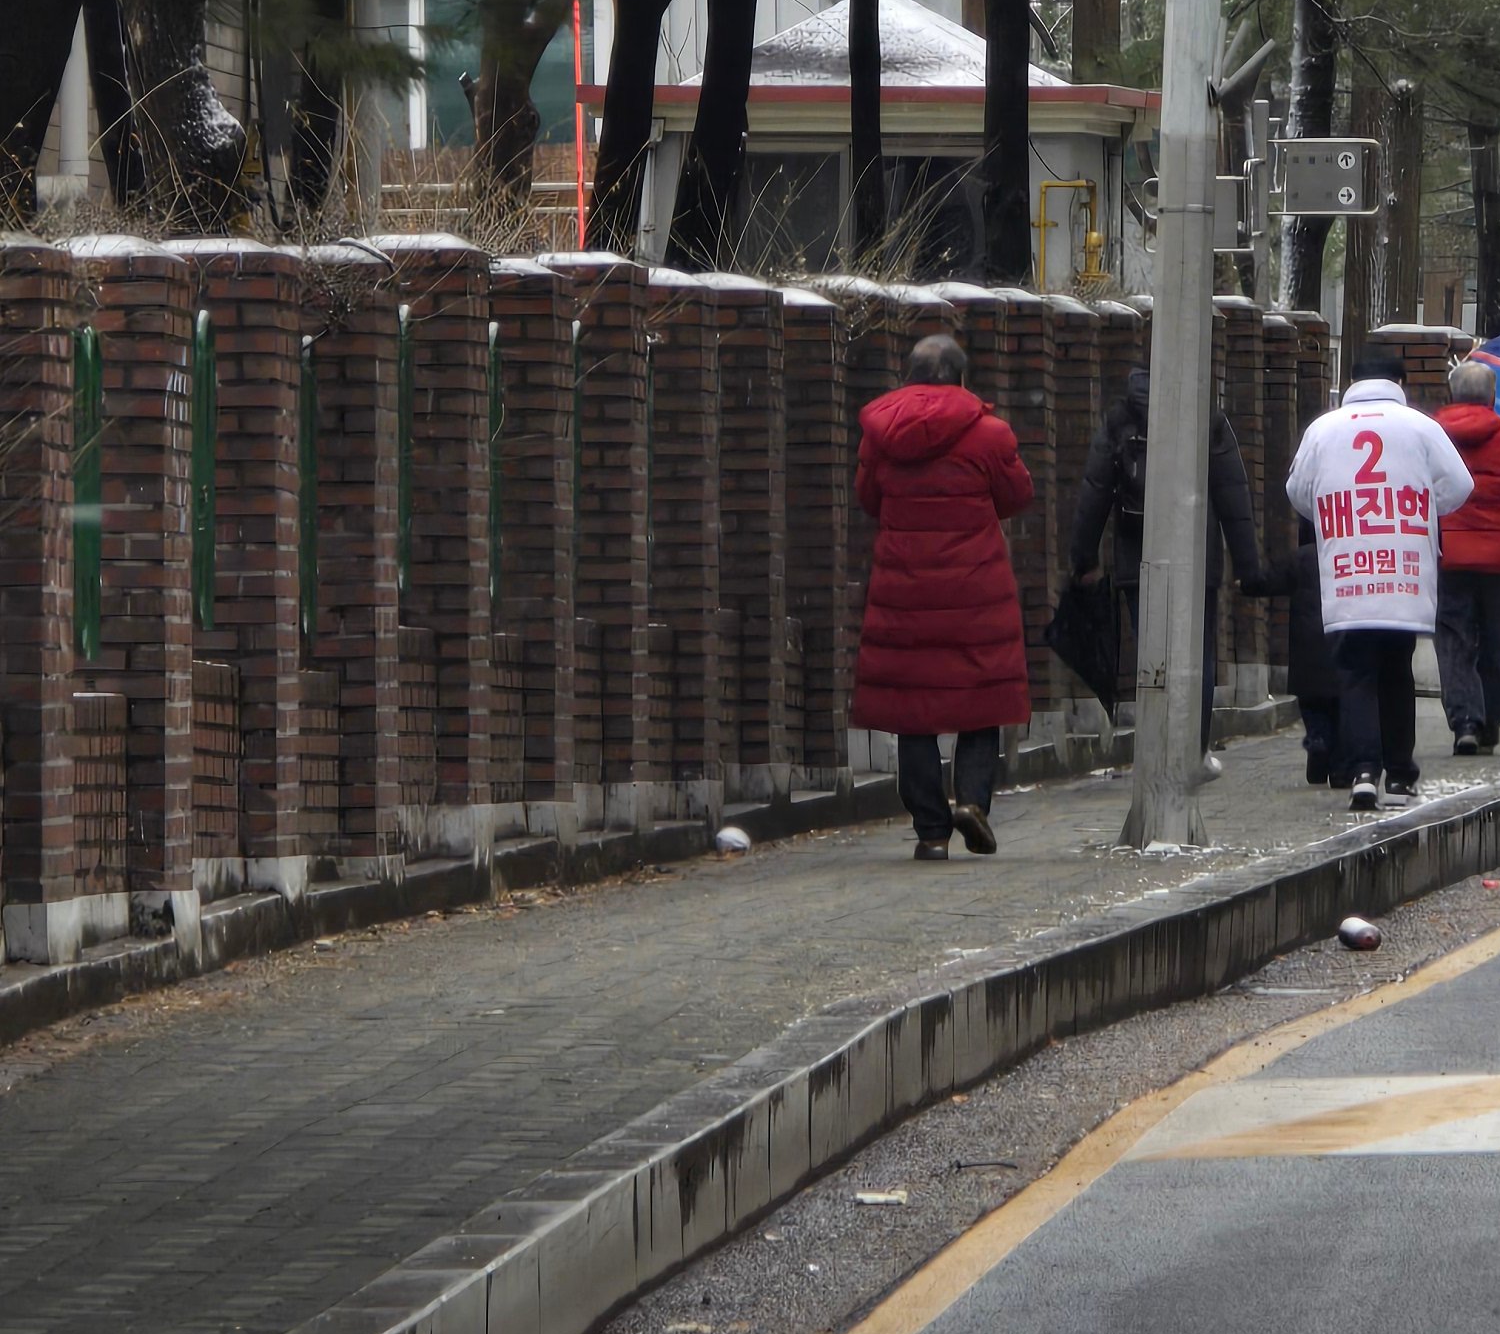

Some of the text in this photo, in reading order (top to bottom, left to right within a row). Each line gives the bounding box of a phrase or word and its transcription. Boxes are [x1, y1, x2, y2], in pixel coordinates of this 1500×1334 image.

[1352, 430, 1386, 485] 2
[1317, 485, 1430, 540] 배진현
[1333, 549, 1397, 580] 도의원
